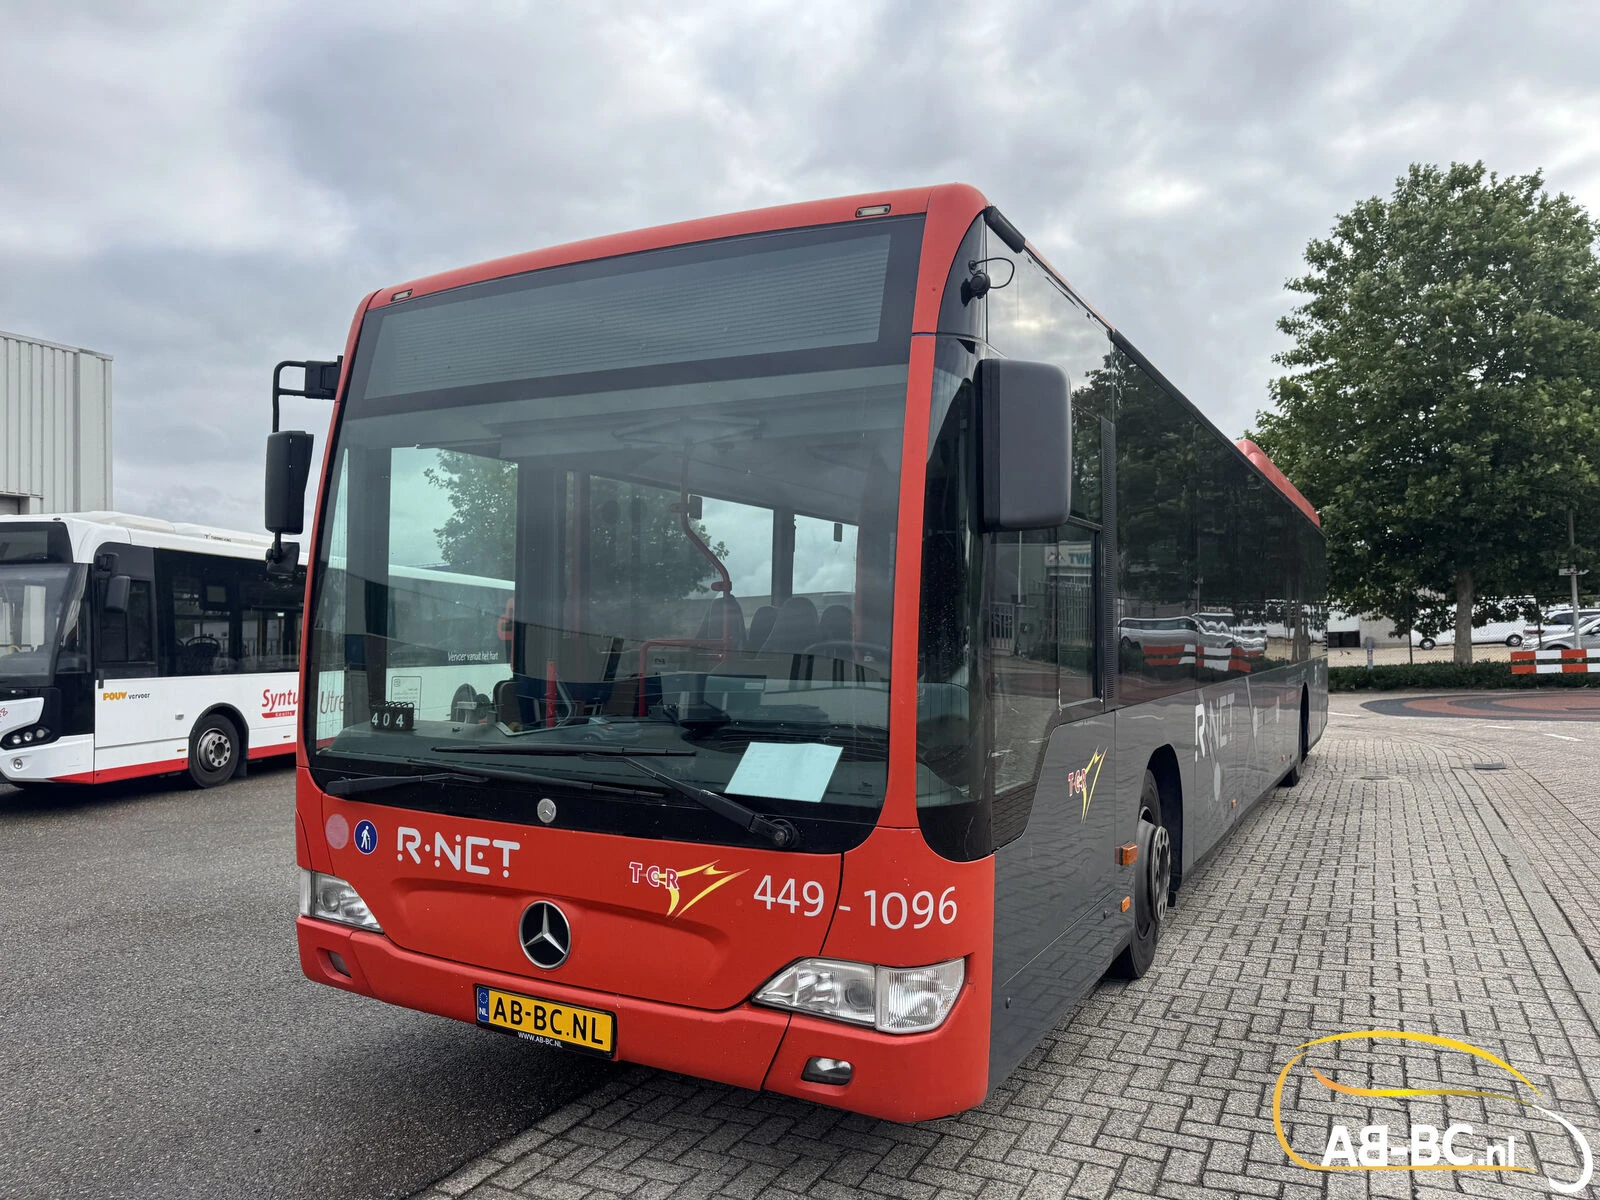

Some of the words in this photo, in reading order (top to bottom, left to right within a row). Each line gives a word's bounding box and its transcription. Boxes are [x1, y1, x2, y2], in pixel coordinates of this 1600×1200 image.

[753, 875, 825, 916] 449
[864, 886, 958, 929] 1096
[479, 1007, 488, 1016] NL
[493, 997, 603, 1045] AB-BC.NL
[518, 1032, 562, 1048] WWW.AB-BC.NL
